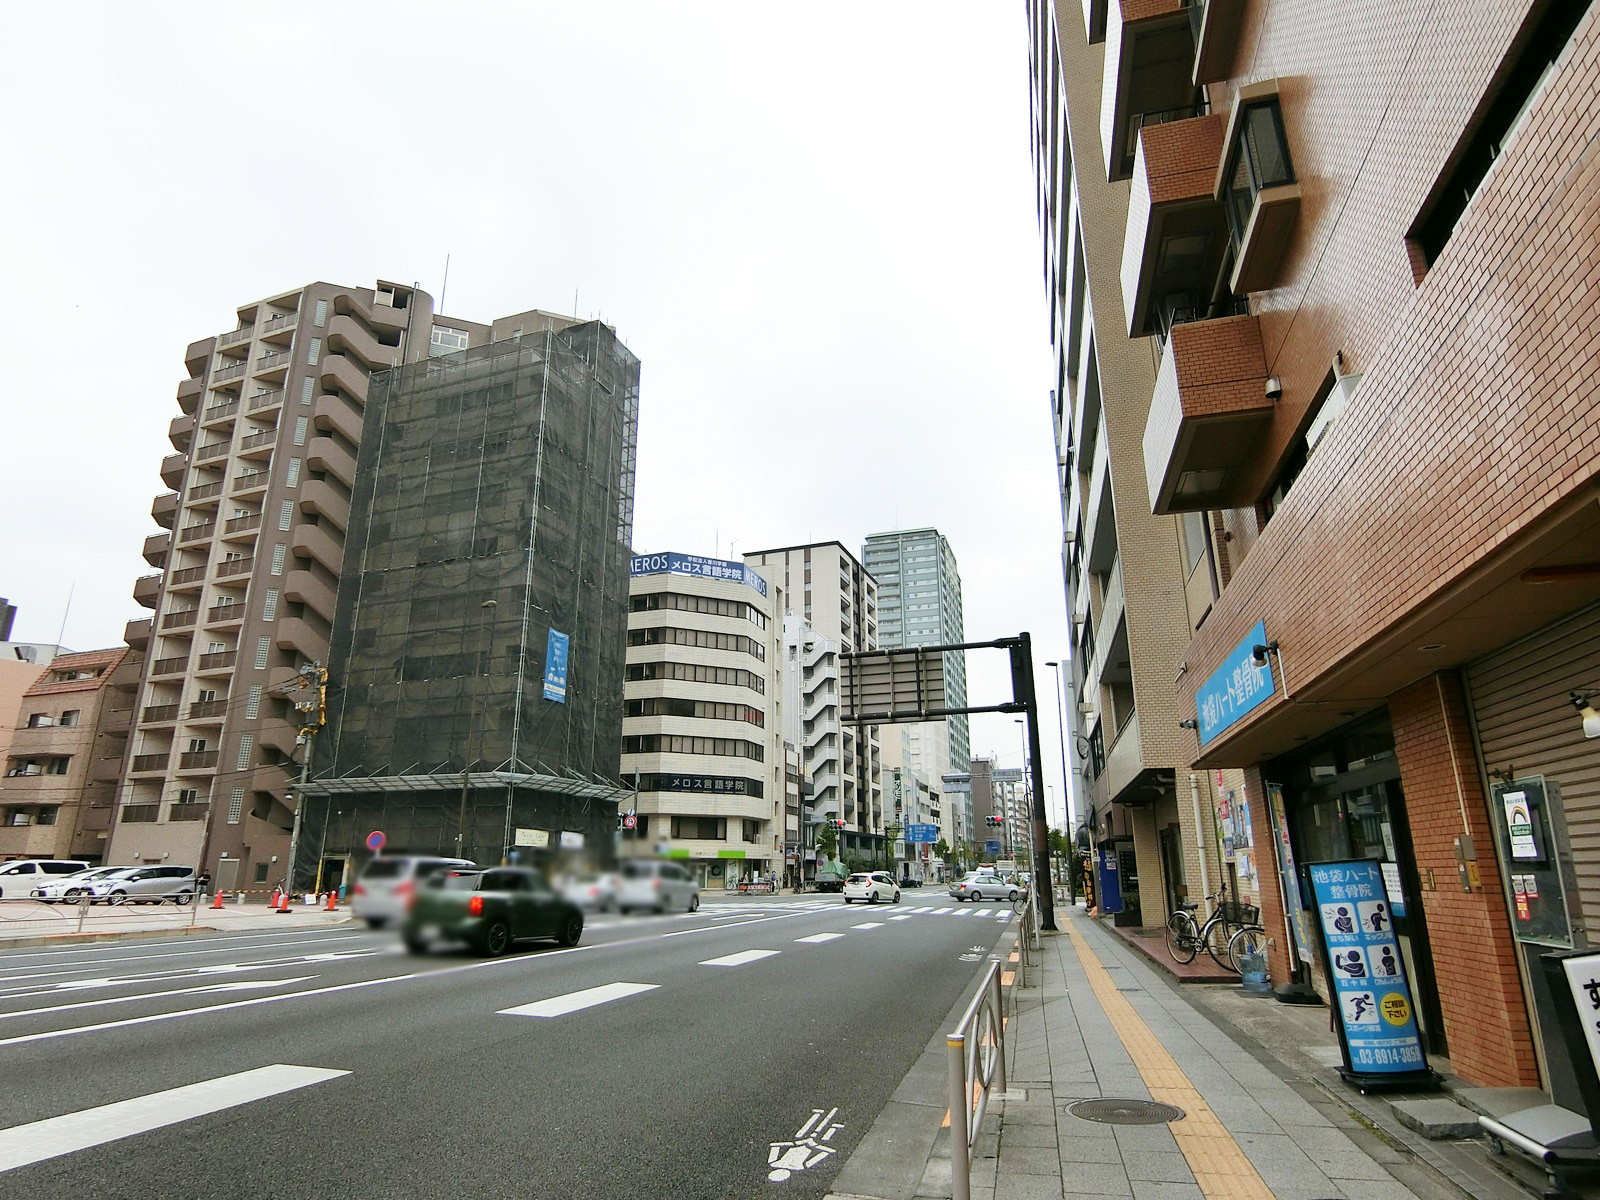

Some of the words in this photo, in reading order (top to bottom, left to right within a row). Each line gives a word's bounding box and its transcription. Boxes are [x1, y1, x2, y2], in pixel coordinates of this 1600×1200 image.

[671, 561, 742, 580] メロス言語学院
[745, 568, 766, 595] MEROS
[671, 777, 745, 792] メロス言語学院
[1314, 867, 1379, 884] 池袋ハート
[1330, 884, 1373, 899] 整骨院
[1386, 1010, 1407, 1019] 下さい
